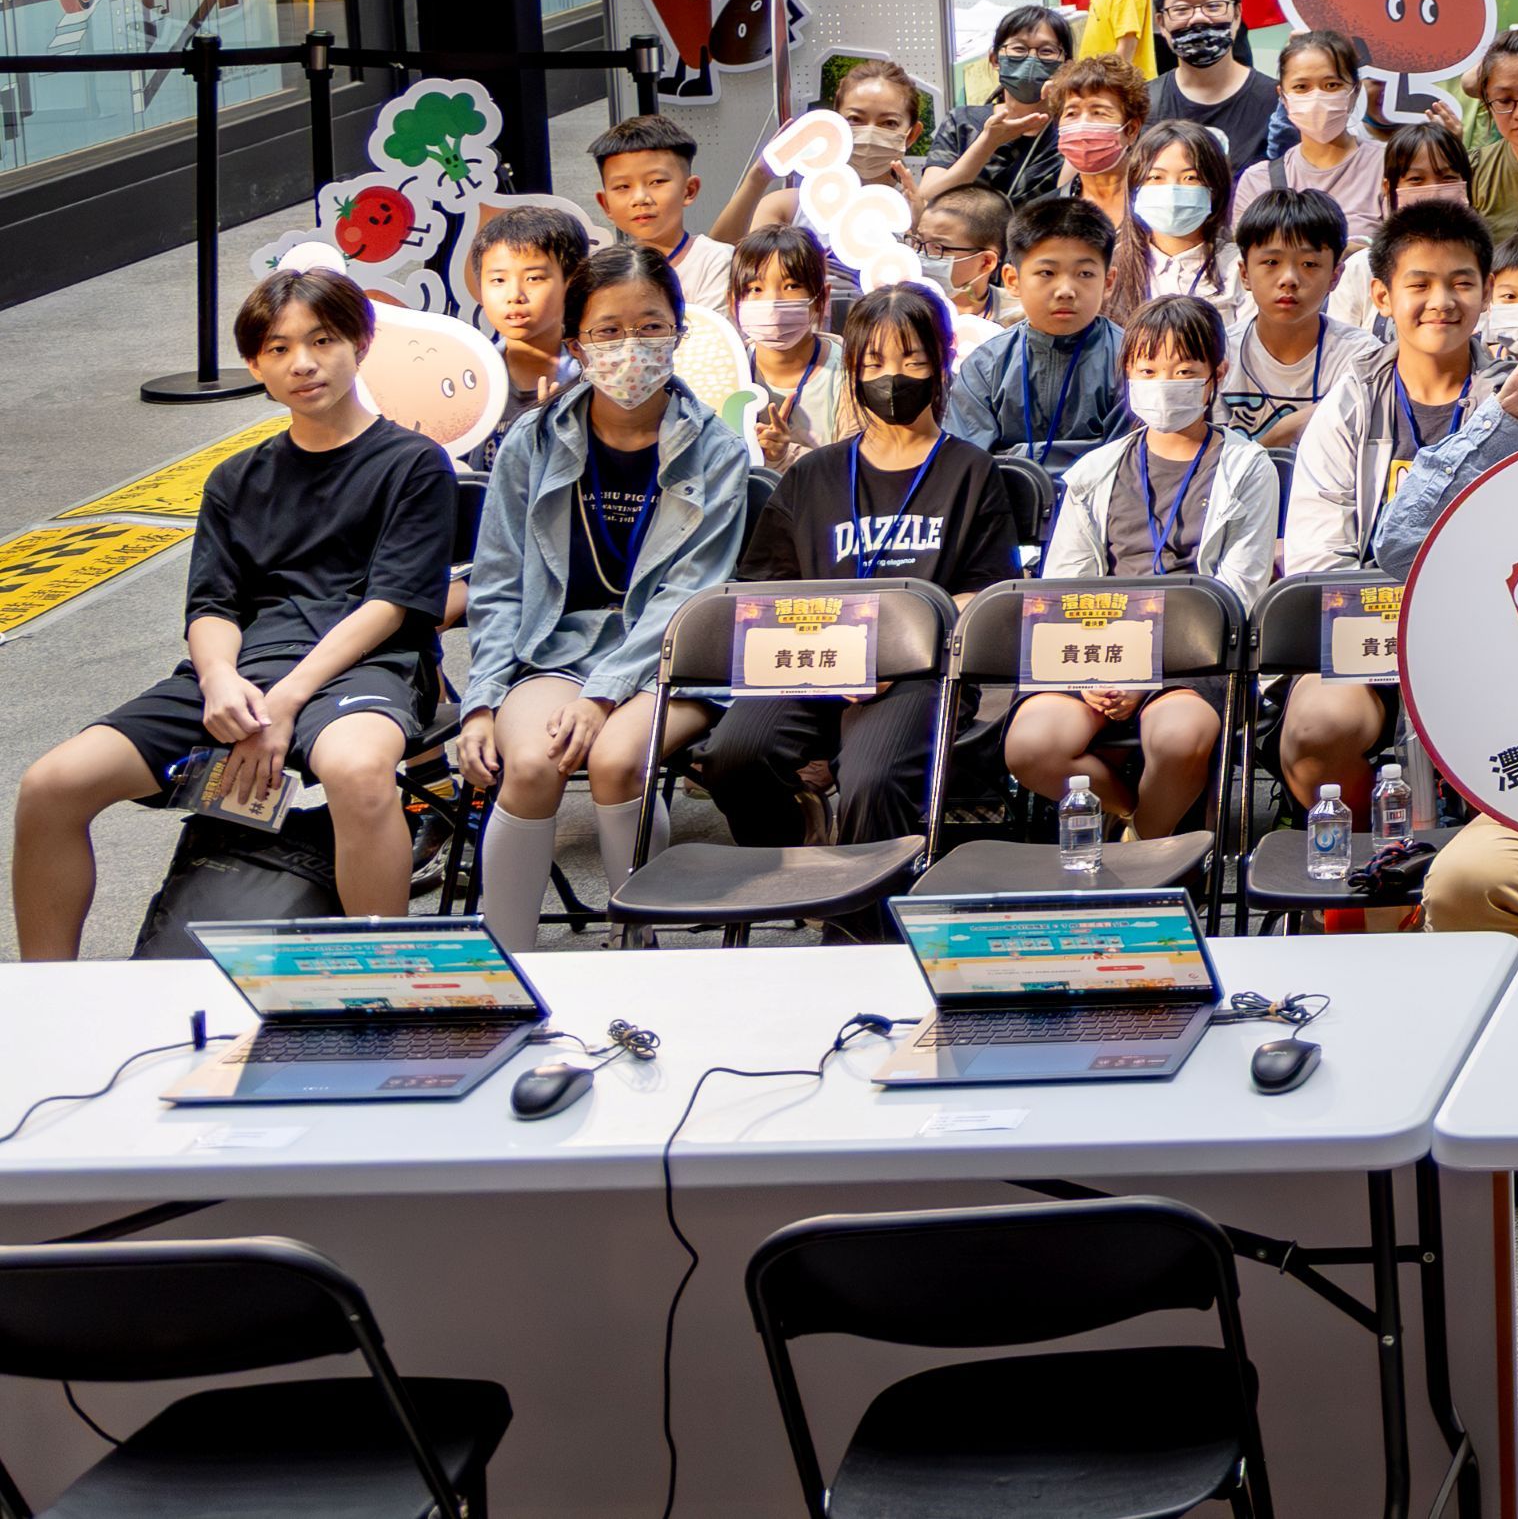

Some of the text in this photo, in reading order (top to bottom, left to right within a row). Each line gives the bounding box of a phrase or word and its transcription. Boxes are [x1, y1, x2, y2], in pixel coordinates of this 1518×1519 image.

[834, 514, 944, 563] DAZZLE
[774, 648, 838, 669] 貴賓席
[1061, 643, 1124, 664] 貴賓席
